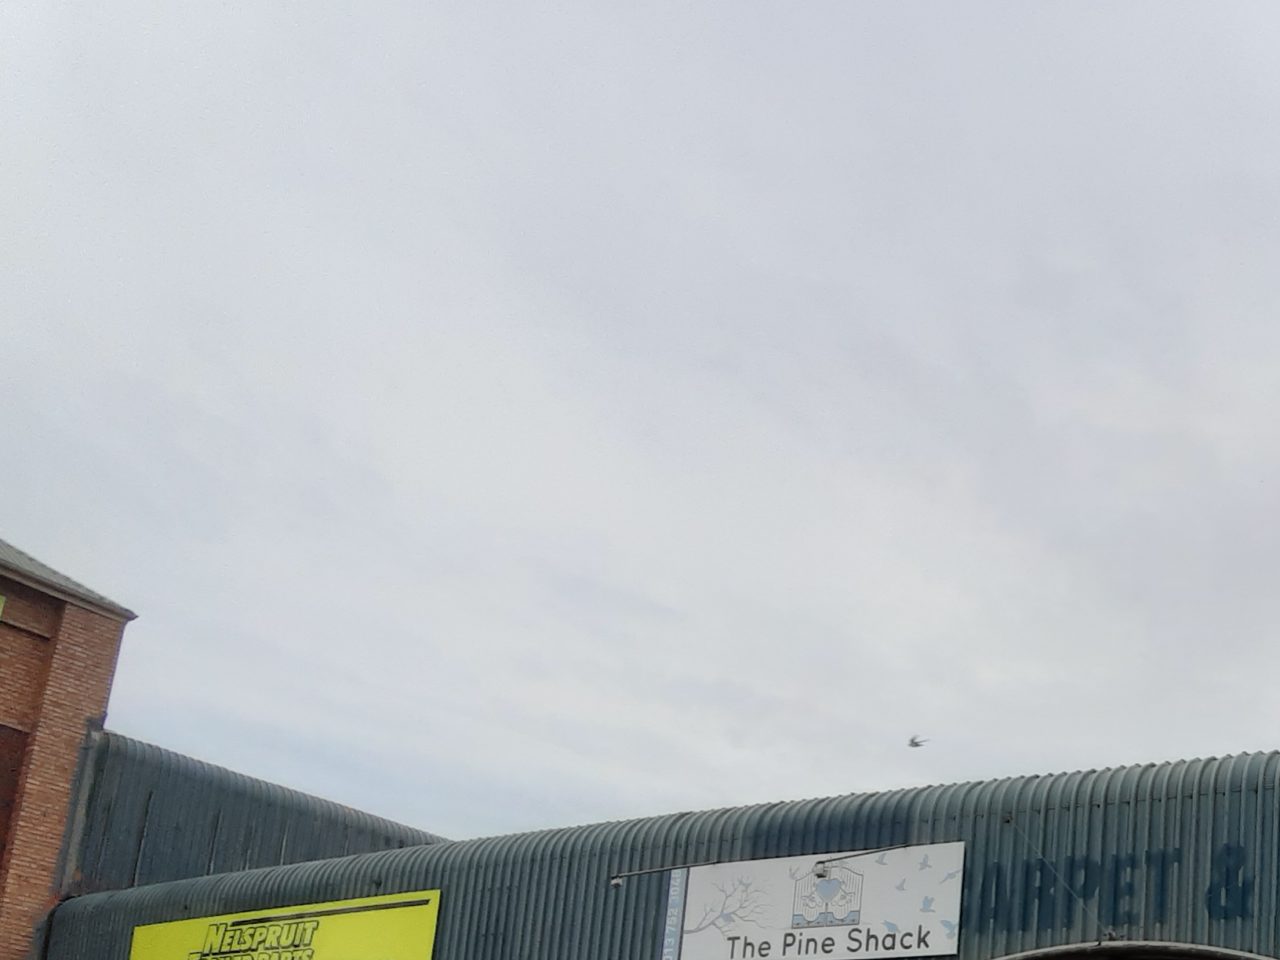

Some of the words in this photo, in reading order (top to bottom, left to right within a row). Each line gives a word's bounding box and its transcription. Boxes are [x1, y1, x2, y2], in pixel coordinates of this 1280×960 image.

[964, 846, 1182, 936] ARPET
[201, 920, 320, 956] NELSPRUIT
[726, 935, 772, 960] The
[782, 932, 836, 957] Pine
[846, 924, 931, 953] Shack
